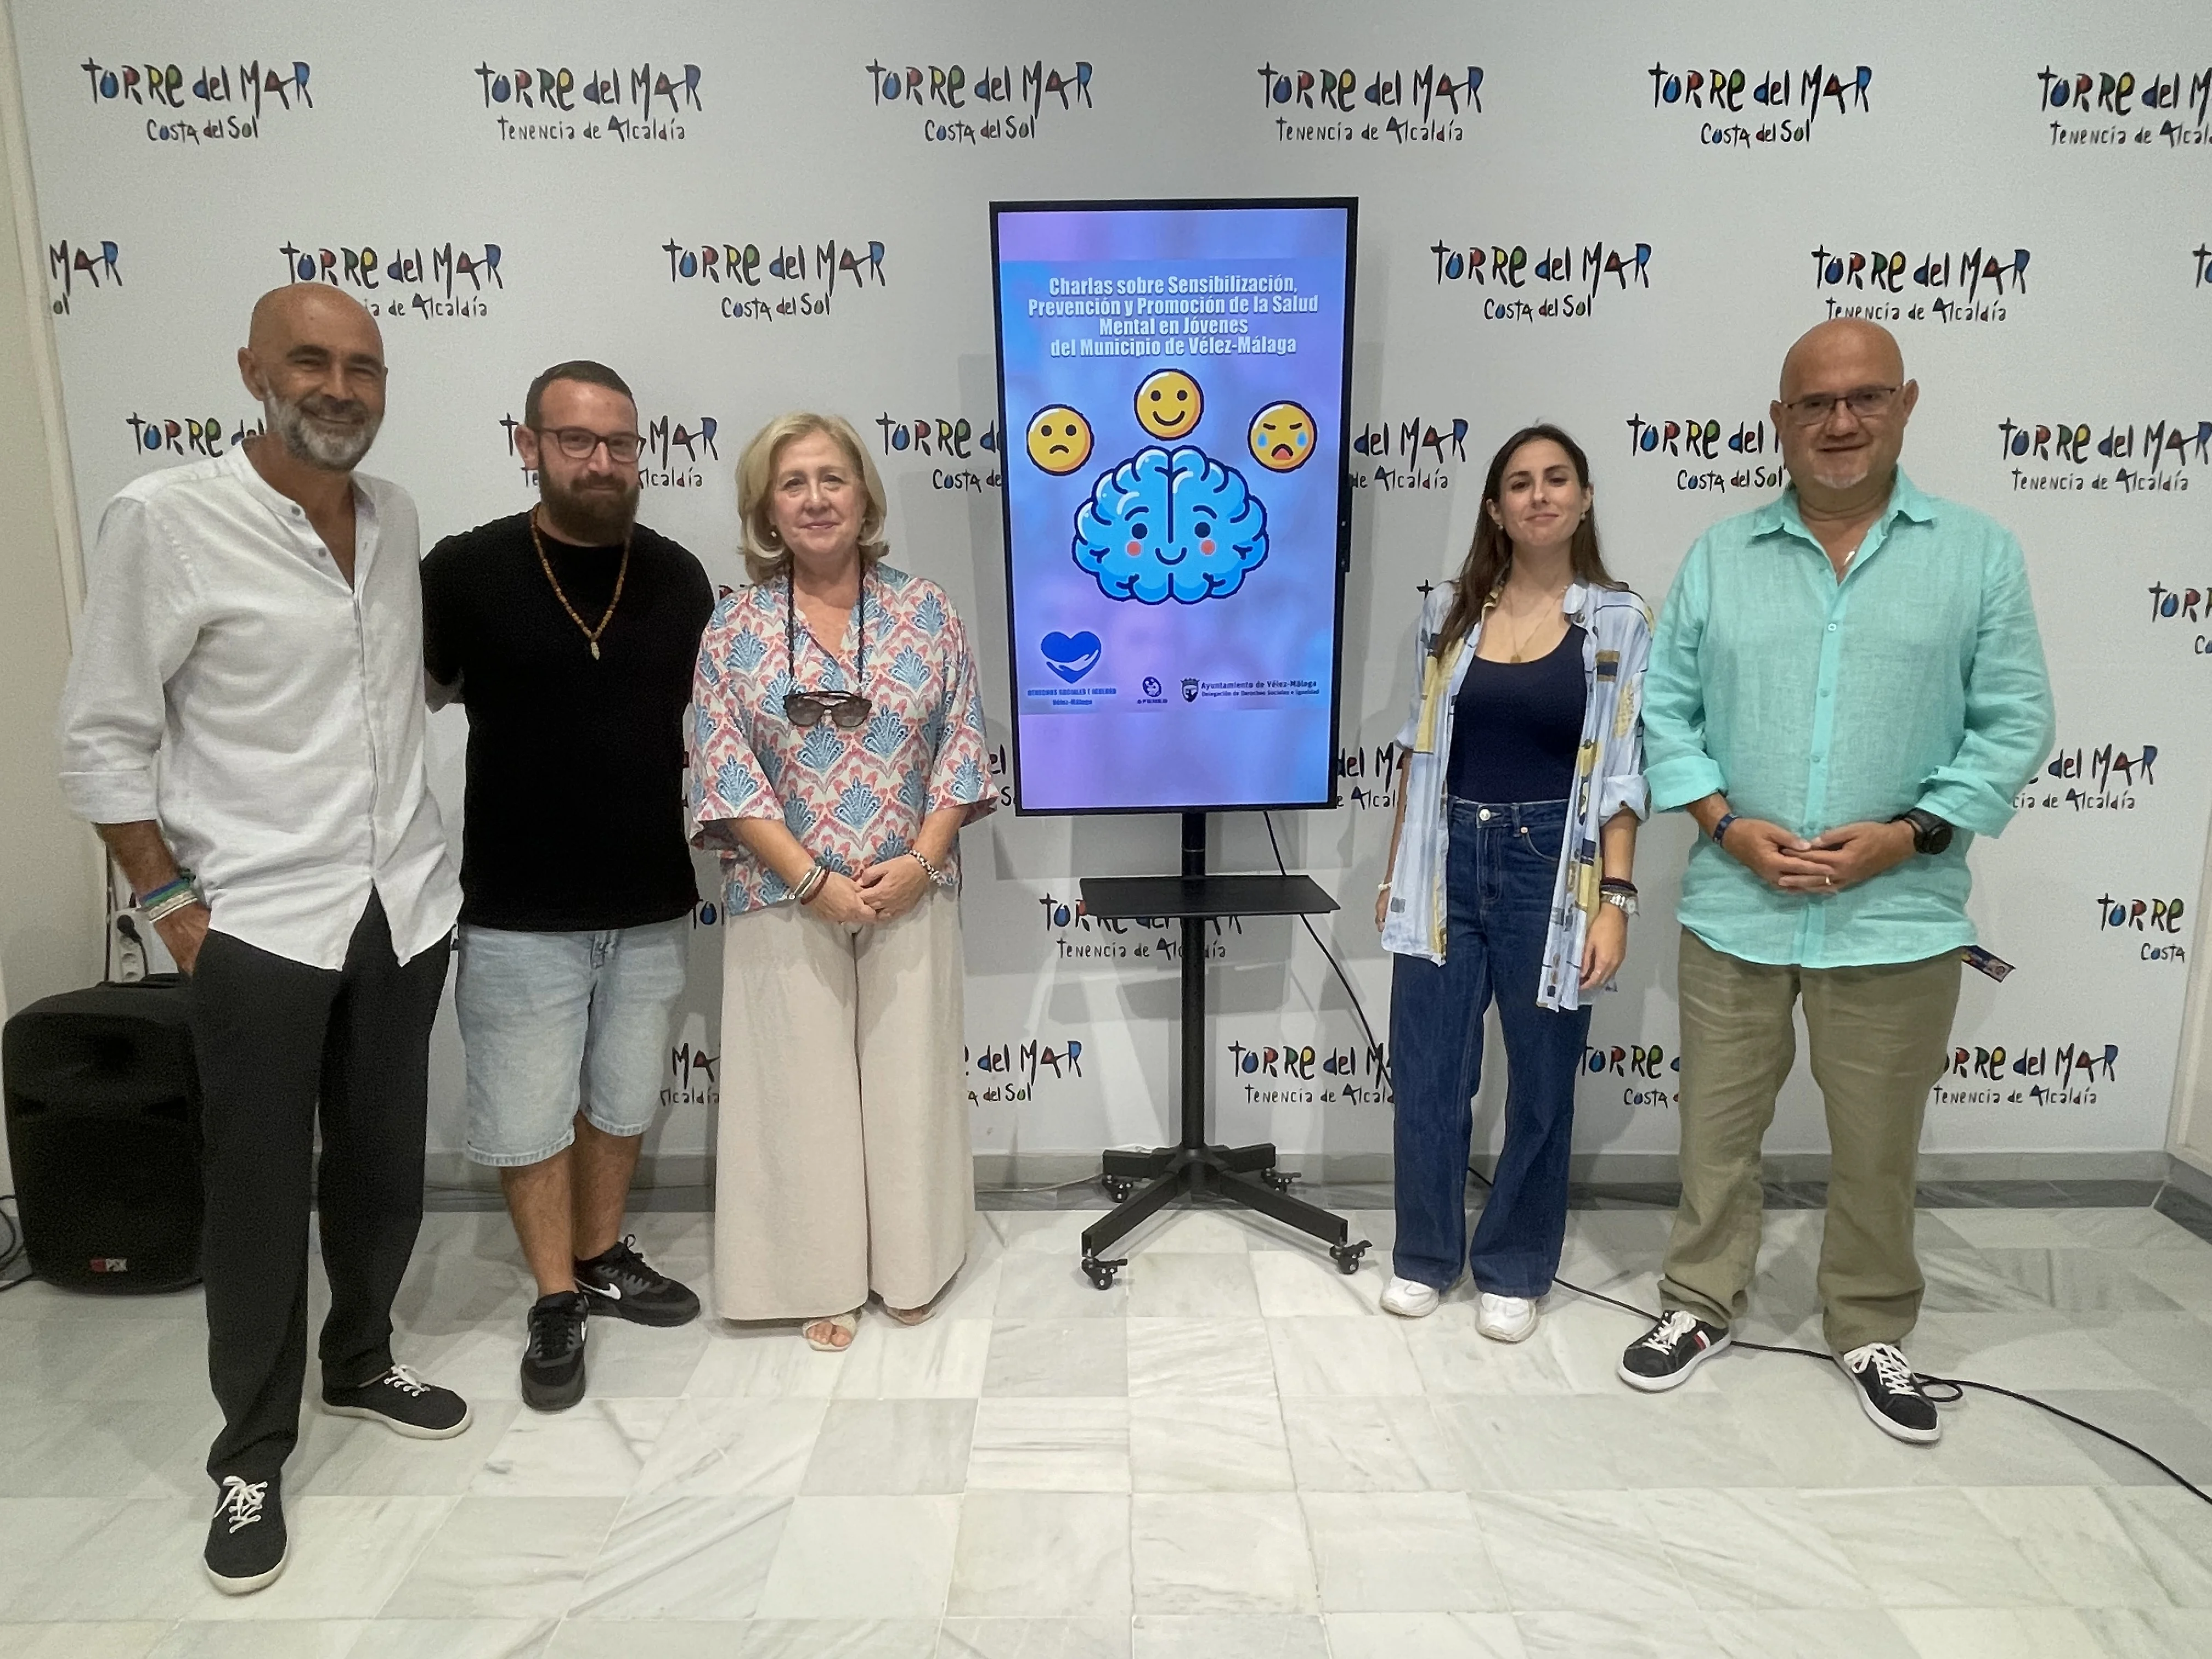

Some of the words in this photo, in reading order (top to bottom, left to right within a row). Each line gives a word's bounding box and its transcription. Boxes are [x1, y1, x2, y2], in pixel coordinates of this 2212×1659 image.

[192, 65, 232, 102] del
[239, 59, 314, 120] MAR
[583, 67, 621, 105] del
[631, 63, 702, 122] MAR
[973, 65, 1011, 103] del
[1023, 60, 1093, 120] MAR
[1364, 69, 1402, 106] del
[1413, 64, 1484, 123] MAR
[1753, 69, 1791, 106] del
[1801, 64, 1872, 123] MAR
[2141, 72, 2180, 110] del
[203, 119, 224, 138] del
[227, 114, 259, 139] Sol
[583, 121, 601, 139] de
[607, 114, 685, 143] Alcaldía
[980, 119, 1001, 139] del
[1005, 114, 1035, 139] Sol
[1361, 123, 1379, 140] de
[1386, 115, 1463, 145] Alcaldía
[1755, 122, 1776, 143] del
[1780, 119, 1810, 143] Sol
[2134, 126, 2152, 145] de
[49, 239, 123, 297] MAR
[387, 247, 424, 284] del
[432, 242, 504, 302] MAR
[769, 245, 805, 281] del
[816, 239, 885, 297] MAR
[1534, 246, 1571, 282] del
[1582, 241, 1651, 299] MAR
[1912, 252, 1950, 288] del
[1960, 247, 2031, 306] MAR
[1049, 276, 1113, 296] Charlas
[1117, 276, 1164, 295] sobre
[1168, 274, 1297, 294] Sensibilización,
[387, 299, 406, 317] de
[411, 292, 487, 320] Alcaldía
[776, 296, 797, 316] del
[800, 291, 830, 316] Sol
[1028, 297, 1121, 315] Prevención
[1124, 300, 1133, 317] y
[1137, 295, 1223, 314] Promoción
[1229, 296, 1249, 313] de
[1253, 296, 1268, 313] la
[1272, 295, 1318, 313] Salud
[1538, 297, 1558, 318] del
[1562, 293, 1592, 318] Sol
[1907, 303, 1925, 320] de
[1931, 296, 2007, 324] Alcaldía
[1099, 318, 1155, 335] Mental
[1159, 320, 1180, 335] en
[1183, 317, 1248, 334] Jóvenes
[1051, 339, 1076, 357] del
[1080, 338, 1161, 358] Municipio
[1165, 338, 1184, 355] de
[1189, 336, 1296, 356] Vélez-Málaga
[650, 415, 719, 472] MAR
[1353, 422, 1389, 456] del
[1400, 416, 1469, 475] MAR
[1727, 420, 1764, 454] del
[2097, 424, 2134, 459] del
[1374, 465, 1448, 492] Alcaldía
[1730, 469, 1750, 488] del
[1754, 465, 1784, 488] Sol
[2091, 473, 2108, 490] de
[2114, 467, 2188, 494] Alcaldía
[2047, 747, 2083, 779] del
[2091, 743, 2158, 795] MAR
[2042, 793, 2058, 809] de
[2065, 788, 2135, 812] Alcaldía
[1133, 943, 1150, 957] de
[977, 1043, 1011, 1073] del
[1020, 1039, 1082, 1086] MAR
[1322, 1046, 1356, 1076] del
[2012, 1047, 2046, 1076] del
[2055, 1042, 2119, 1093] MAR
[983, 1086, 1001, 1102] del
[1005, 1082, 1032, 1102] Sol
[1319, 1088, 1336, 1103] de
[2007, 1090, 2023, 1104] de
[2029, 1084, 2097, 1107] Alcaldía
